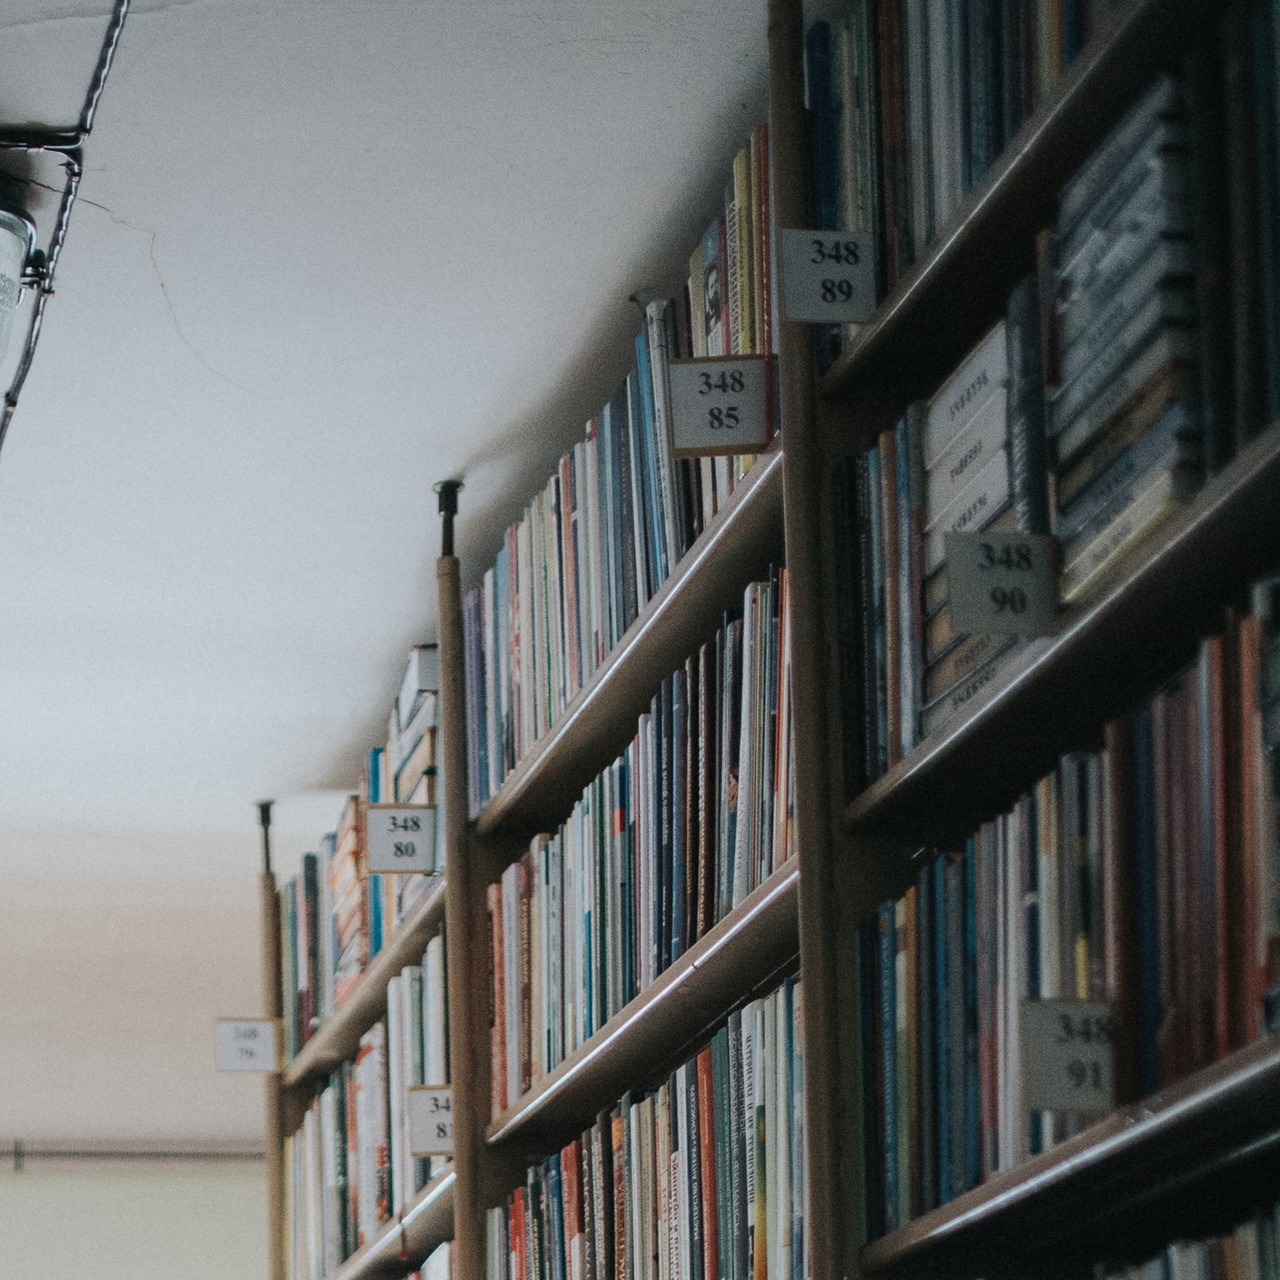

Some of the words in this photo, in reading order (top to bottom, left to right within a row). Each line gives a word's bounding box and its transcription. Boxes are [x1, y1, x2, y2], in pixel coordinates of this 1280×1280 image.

[810, 240, 860, 266] 348
[821, 278, 852, 304] 89
[698, 371, 745, 395] 348
[709, 407, 740, 431] 85
[979, 543, 1032, 572] 348
[991, 588, 1026, 614] 90
[387, 816, 421, 832] 348
[394, 842, 415, 857] 80
[1057, 1014, 1114, 1041] 348
[745, 1035, 754, 1098] МАТЕРИАЛЫ
[1068, 1062, 1103, 1090] 91
[747, 1115, 754, 1129] ИХ
[671, 1156, 679, 1220] ЭЙНШТЕЙН
